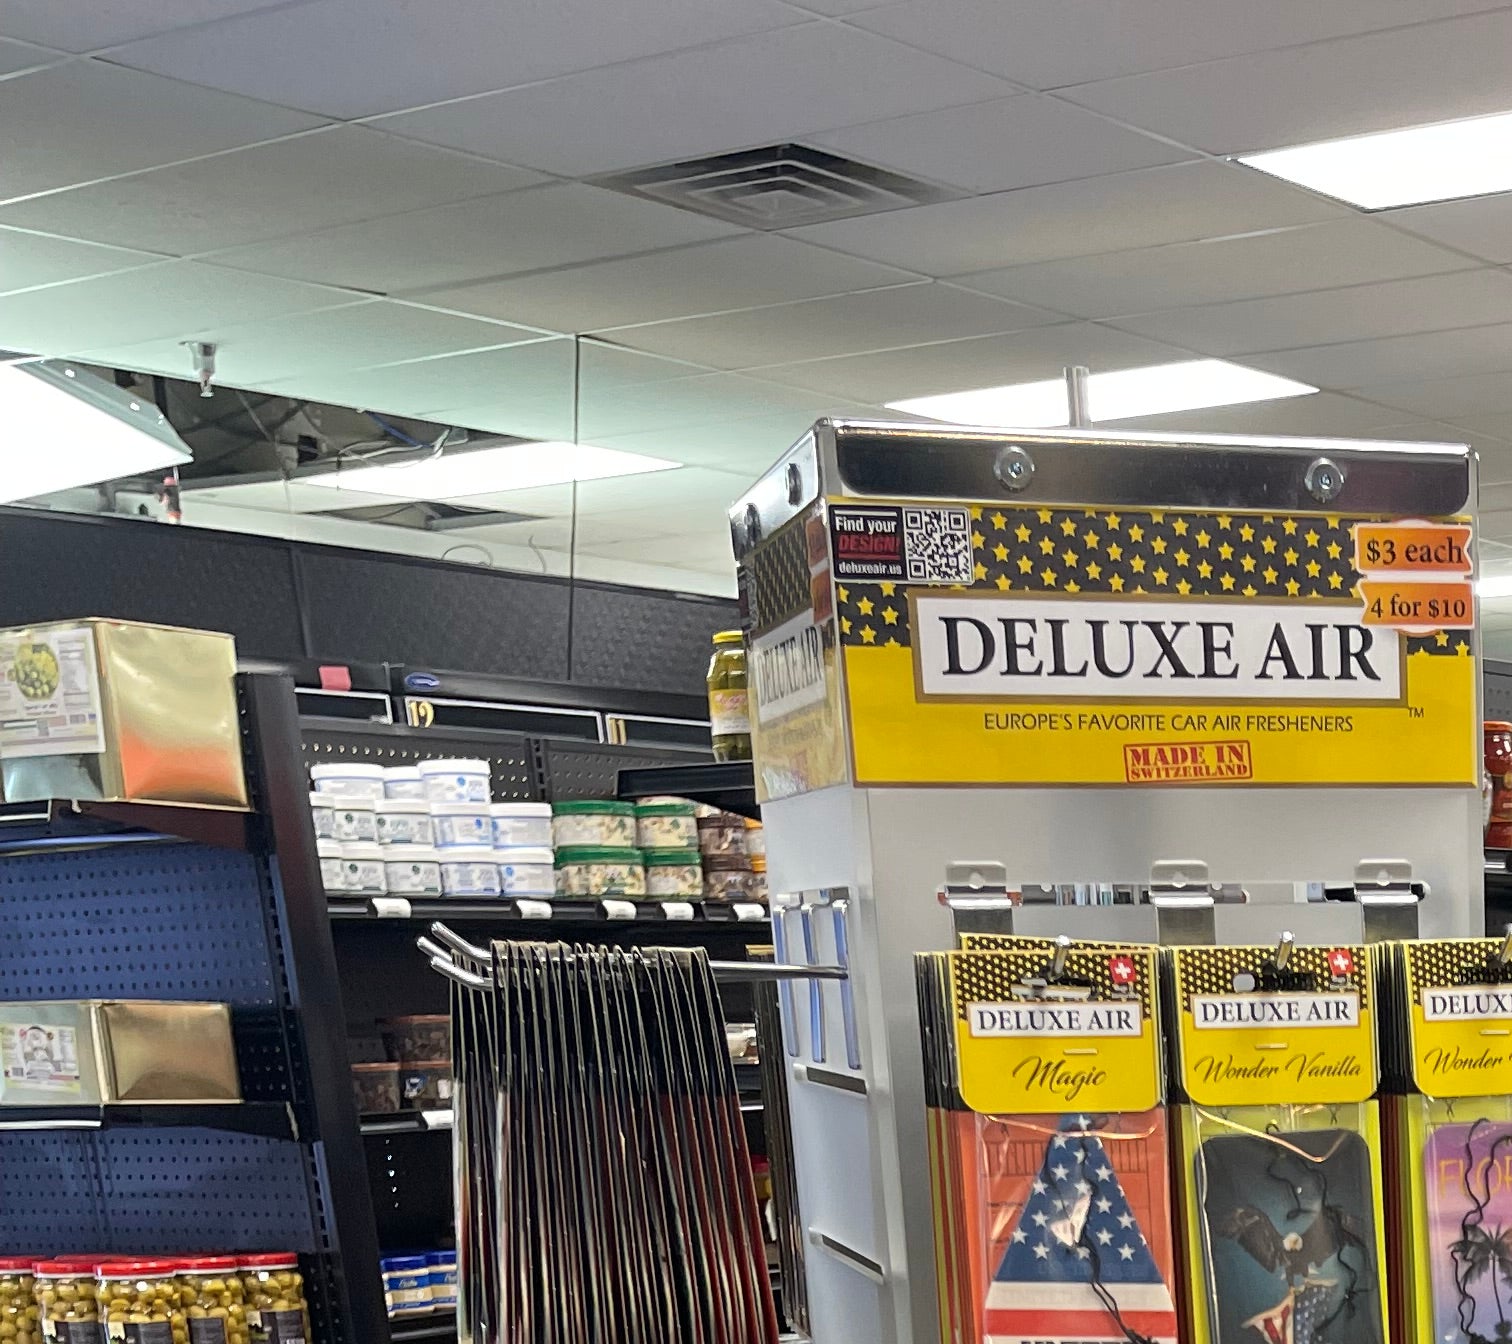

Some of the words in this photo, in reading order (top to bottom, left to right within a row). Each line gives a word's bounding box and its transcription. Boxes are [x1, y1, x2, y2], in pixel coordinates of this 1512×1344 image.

[835, 517, 864, 532] Find
[867, 519, 897, 535] your
[838, 535, 901, 553] DESIGN!
[1366, 538, 1396, 564] $3
[1403, 542, 1466, 565] each
[839, 562, 902, 575] deluxeair.us
[1371, 598, 1384, 619] 4
[1390, 596, 1422, 618] for
[1427, 596, 1466, 620] $10
[942, 616, 1239, 681] DELUXE
[1254, 622, 1381, 682] AIR
[984, 713, 1074, 732] EUROPE'S
[1078, 714, 1166, 732] FAVORITE
[1171, 715, 1208, 732] CAR
[1211, 715, 1242, 733] AIR
[1247, 715, 1353, 734] FRESHENERS
[1130, 745, 1201, 770] MADE
[1207, 744, 1245, 766] IN
[1130, 761, 1250, 781] SWITZERLAND
[977, 1009, 1082, 1032] DELUXE
[1088, 1009, 1134, 1031] AIR
[1201, 1002, 1298, 1024] DELUXE
[1303, 1001, 1352, 1022] AIR
[1195, 1054, 1280, 1085] Wonder
[1286, 1053, 1364, 1080] Vanilla
[1424, 1047, 1511, 1074] Wonder
[1012, 1055, 1107, 1101] Magic
